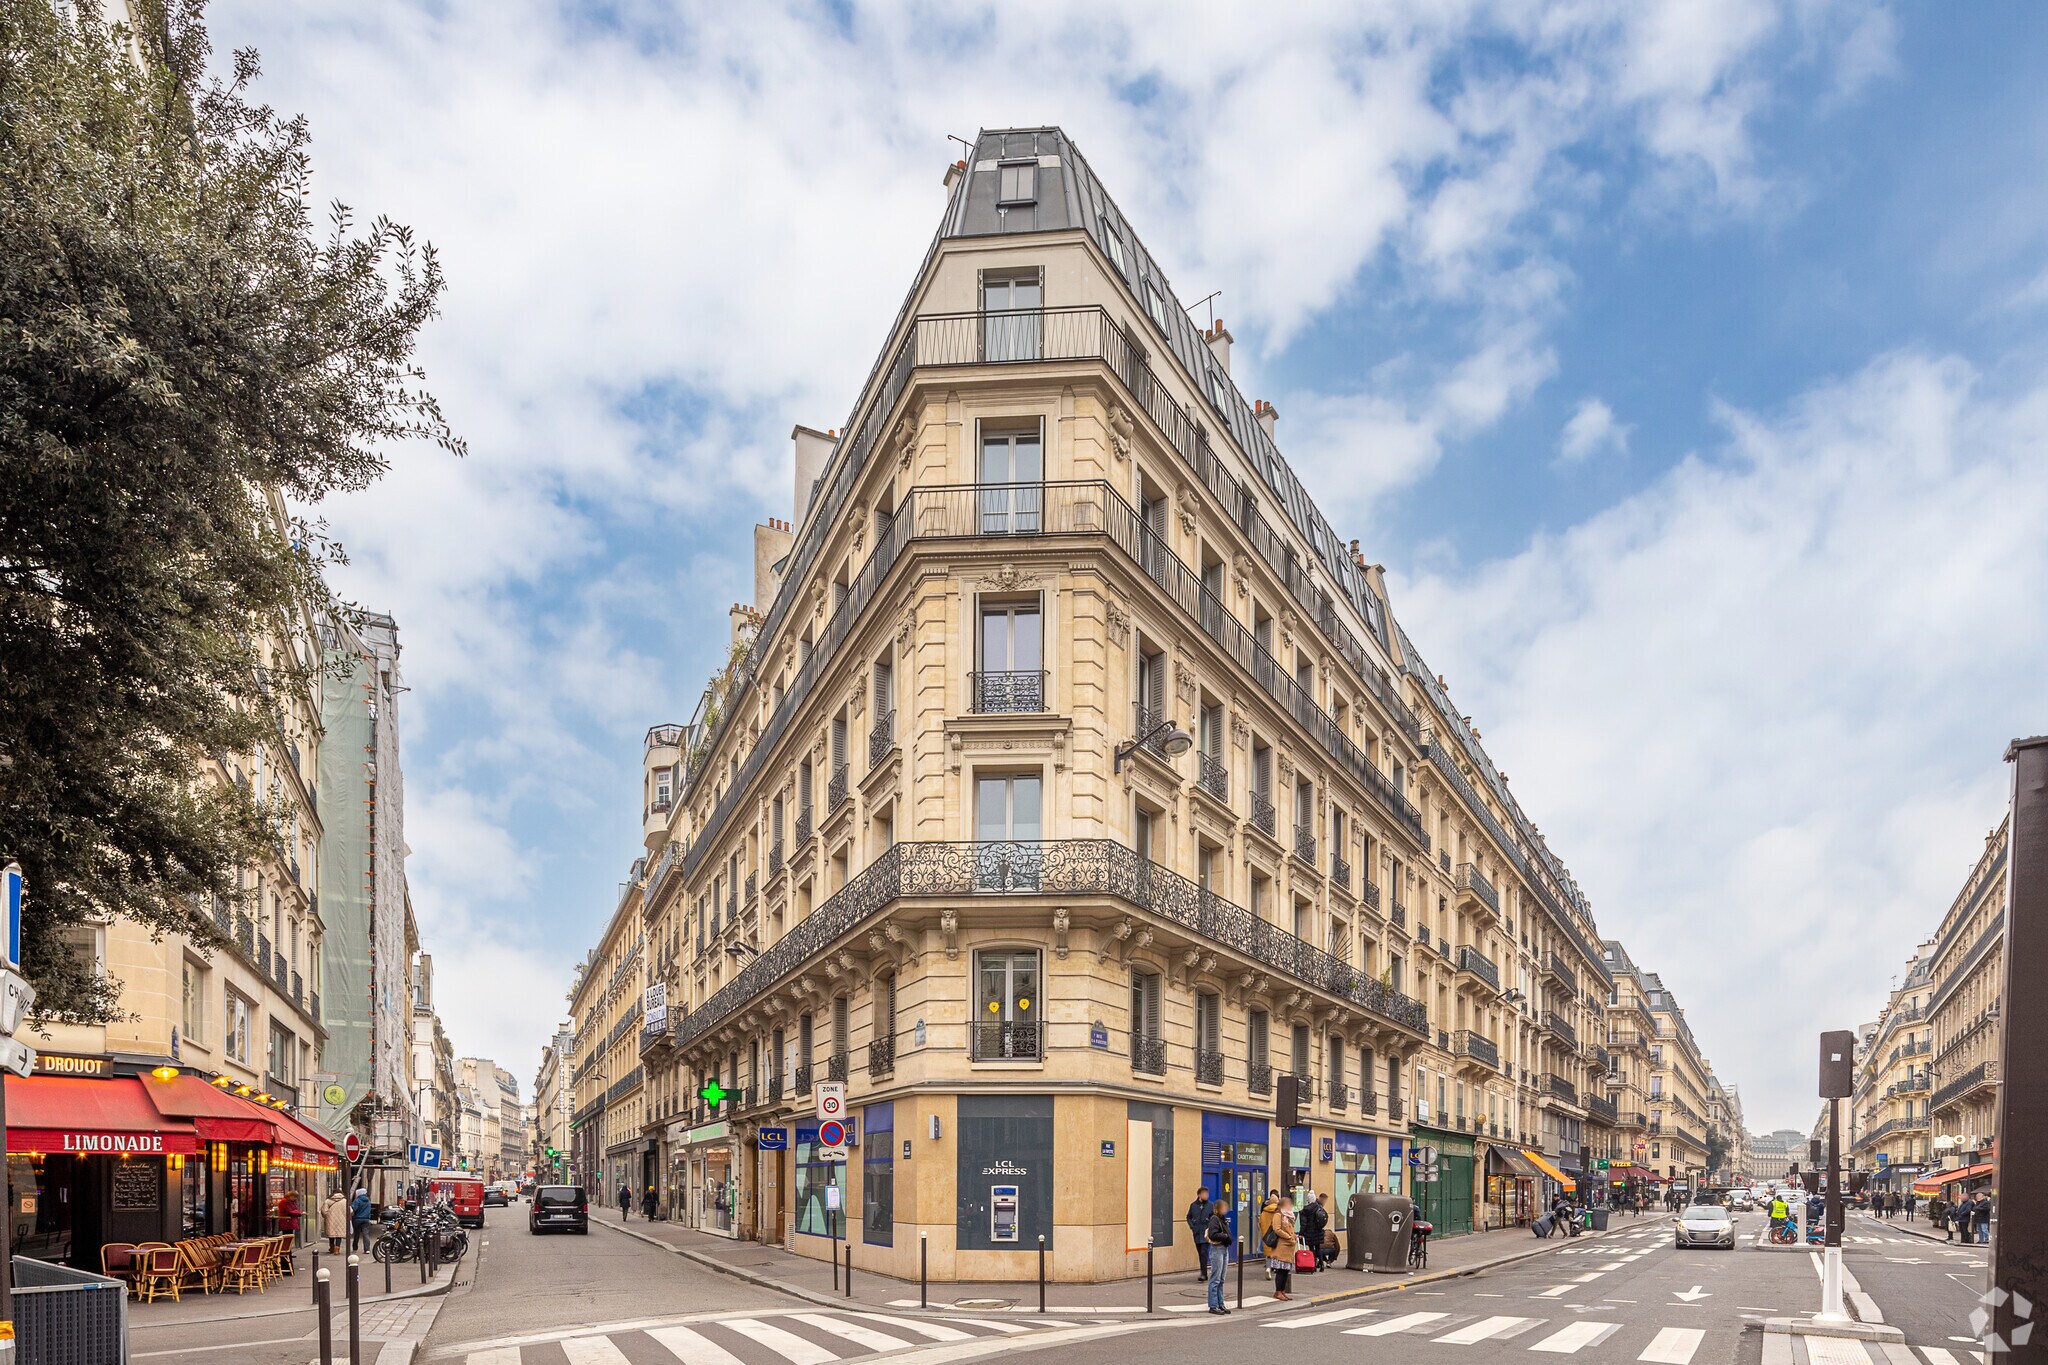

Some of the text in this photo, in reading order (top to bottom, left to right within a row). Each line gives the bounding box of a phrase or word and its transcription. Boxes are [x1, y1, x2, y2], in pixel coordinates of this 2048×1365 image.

[45, 1056, 103, 1074] DROUOT
[63, 1134, 163, 1151] LIMONADE
[423, 1150, 435, 1163] P
